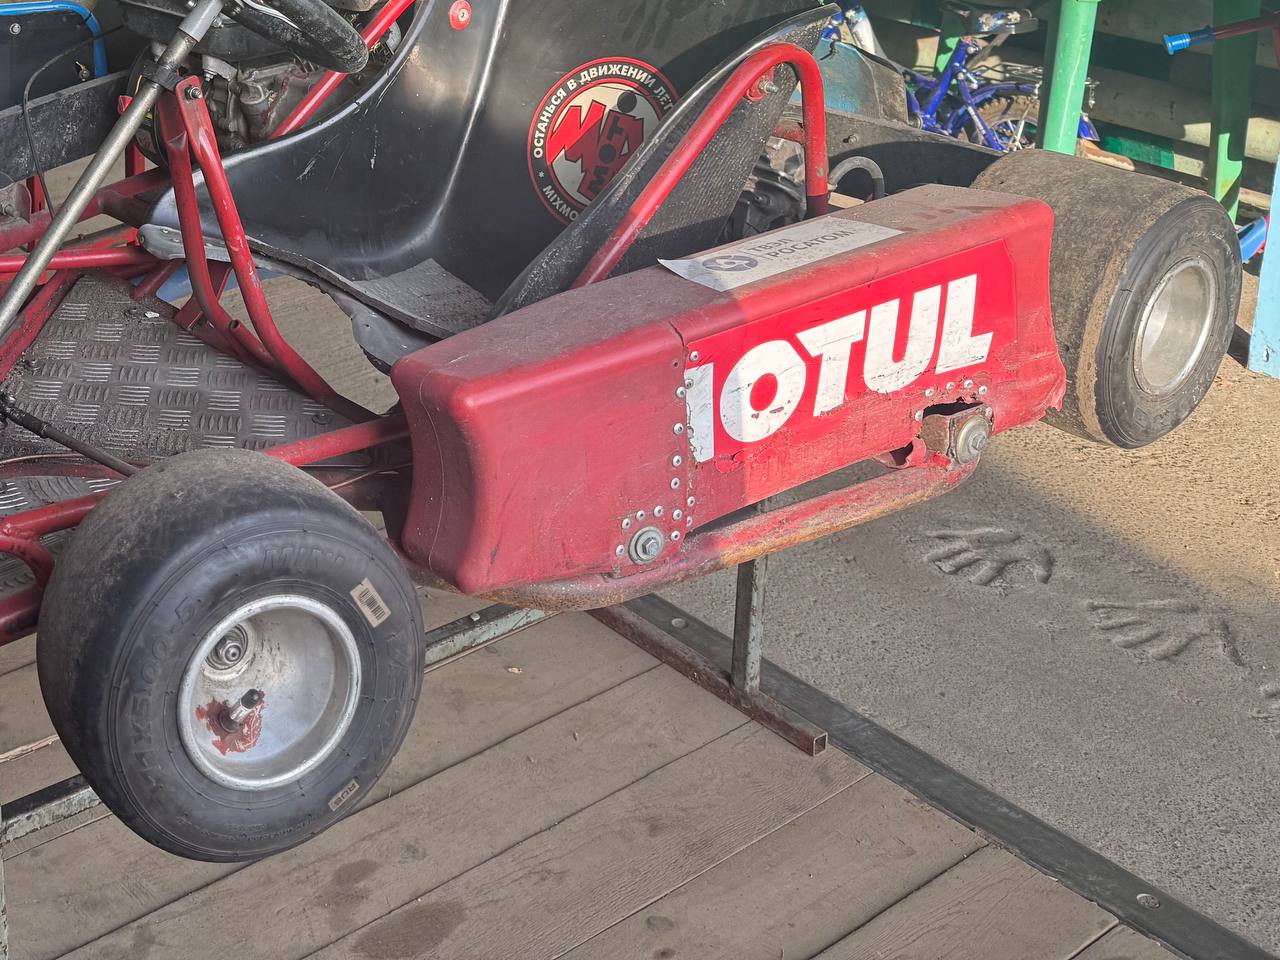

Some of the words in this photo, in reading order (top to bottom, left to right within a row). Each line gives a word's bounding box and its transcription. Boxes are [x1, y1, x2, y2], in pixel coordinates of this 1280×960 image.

[533, 87, 567, 158] ОСТАНЬСЯ
[567, 79, 578, 91] В
[578, 64, 657, 88] ДВИЖЕНИИ
[747, 238, 791, 253] ТВЭЛ
[766, 229, 853, 259] РОСАТОМ
